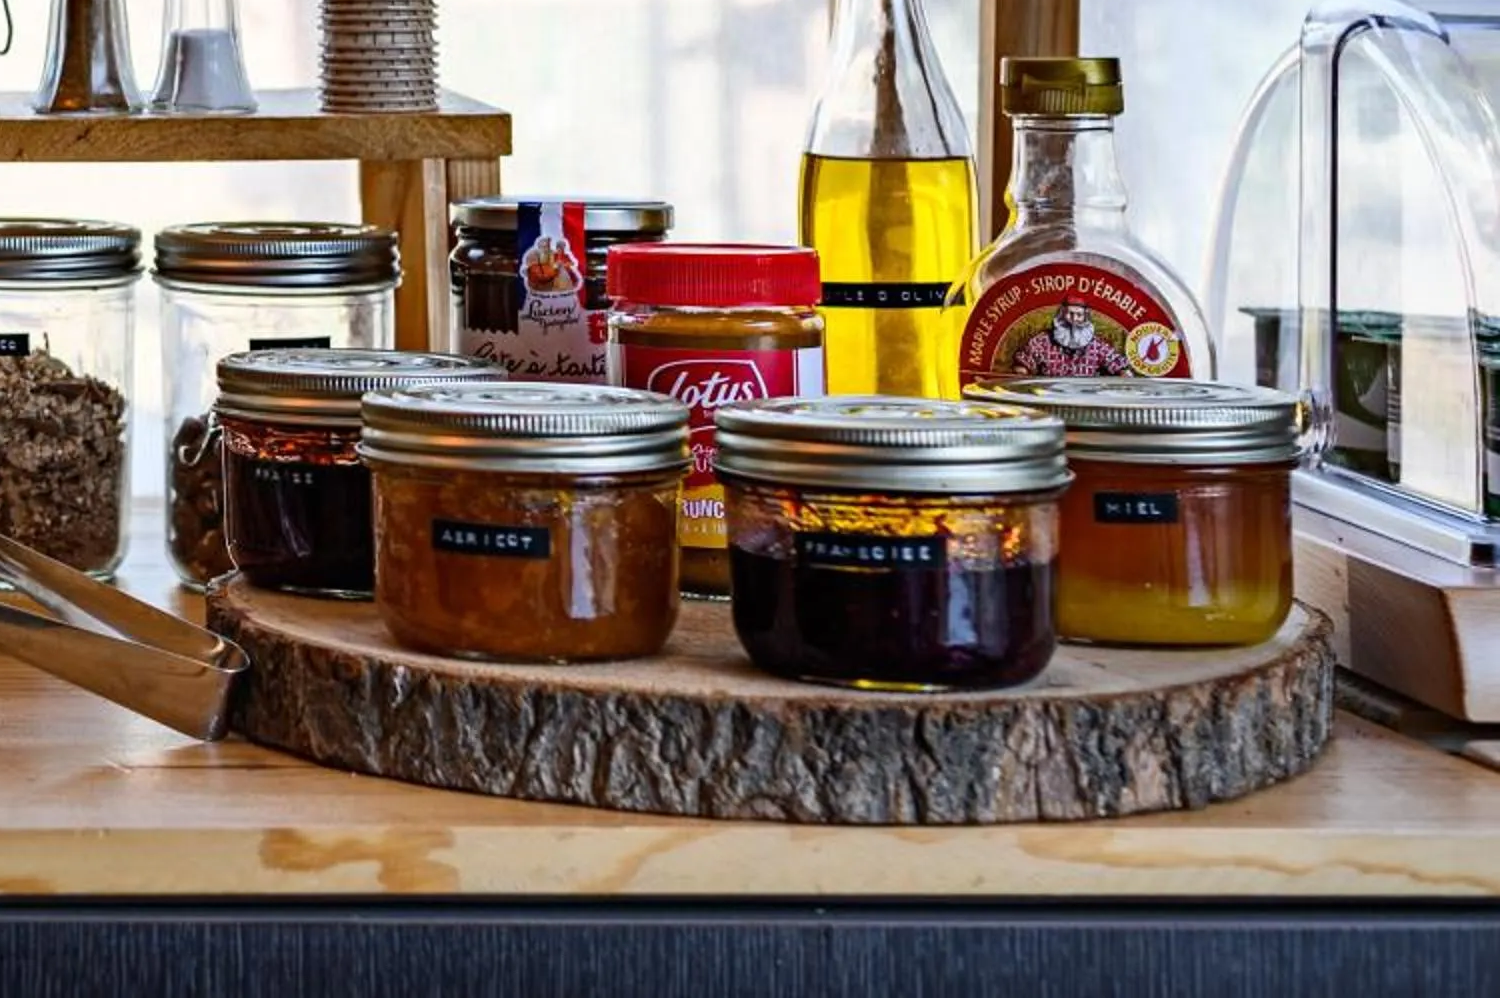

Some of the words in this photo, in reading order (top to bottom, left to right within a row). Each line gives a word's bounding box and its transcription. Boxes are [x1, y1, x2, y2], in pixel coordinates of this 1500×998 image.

[901, 289, 947, 302] OLIV
[969, 317, 993, 366] MAPLE
[985, 285, 1021, 323] SYRUP
[1031, 275, 1076, 295] SIROP
[1078, 277, 1147, 321] D'ÉRABLE
[548, 352, 607, 376] tarti
[1105, 502, 1161, 515] MIEL
